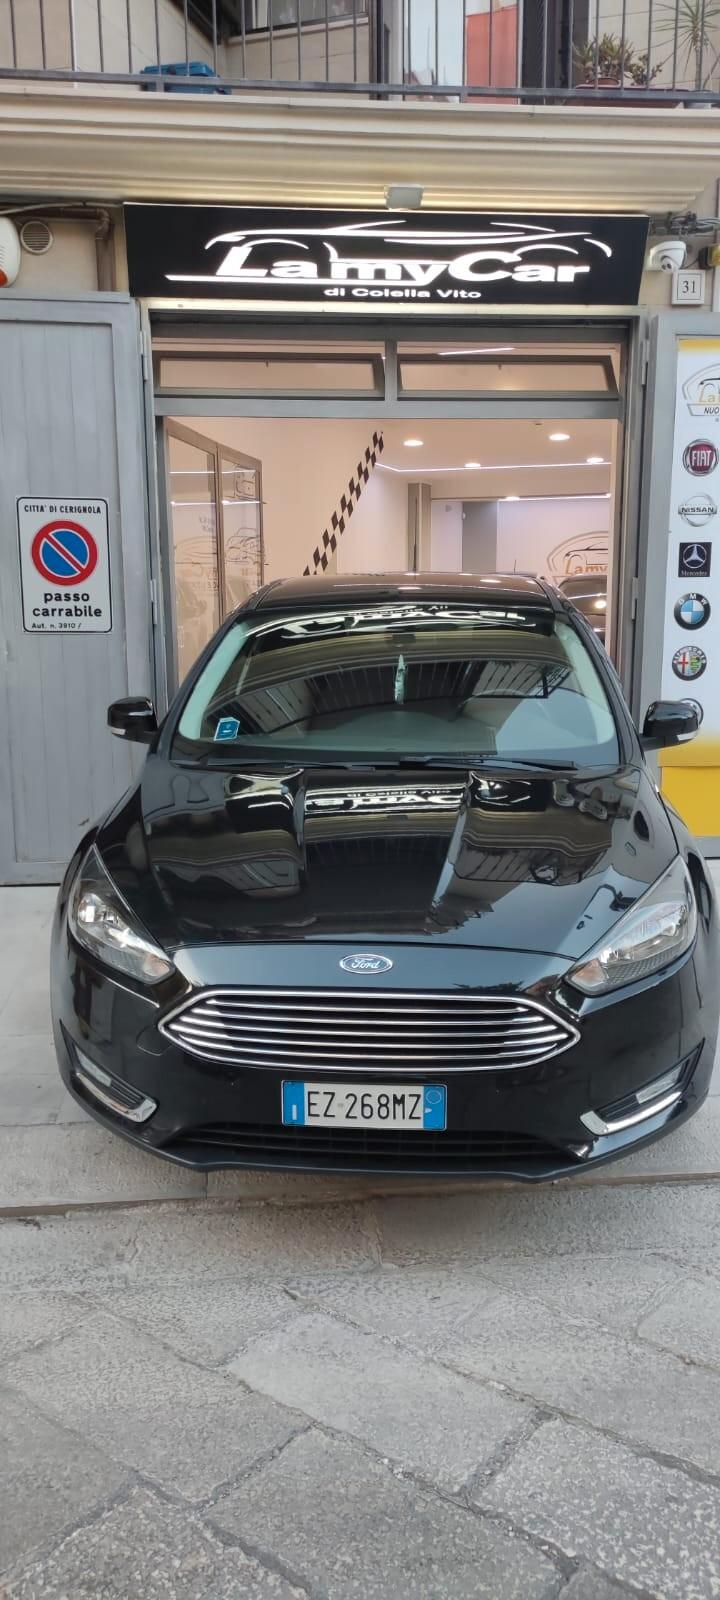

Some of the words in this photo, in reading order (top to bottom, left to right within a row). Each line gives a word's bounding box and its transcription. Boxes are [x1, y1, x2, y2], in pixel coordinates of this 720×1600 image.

[681, 279, 697, 294] 31
[323, 287, 346, 297] di
[351, 288, 430, 298] Colella
[436, 289, 482, 299] Vito
[691, 450, 713, 467] FIAT
[49, 505, 57, 513] DI
[59, 505, 102, 514] CERIGNOLA
[44, 592, 90, 604] passo
[32, 605, 102, 617] carrabile
[351, 958, 380, 969] Ford
[307, 1091, 336, 1118] EZ
